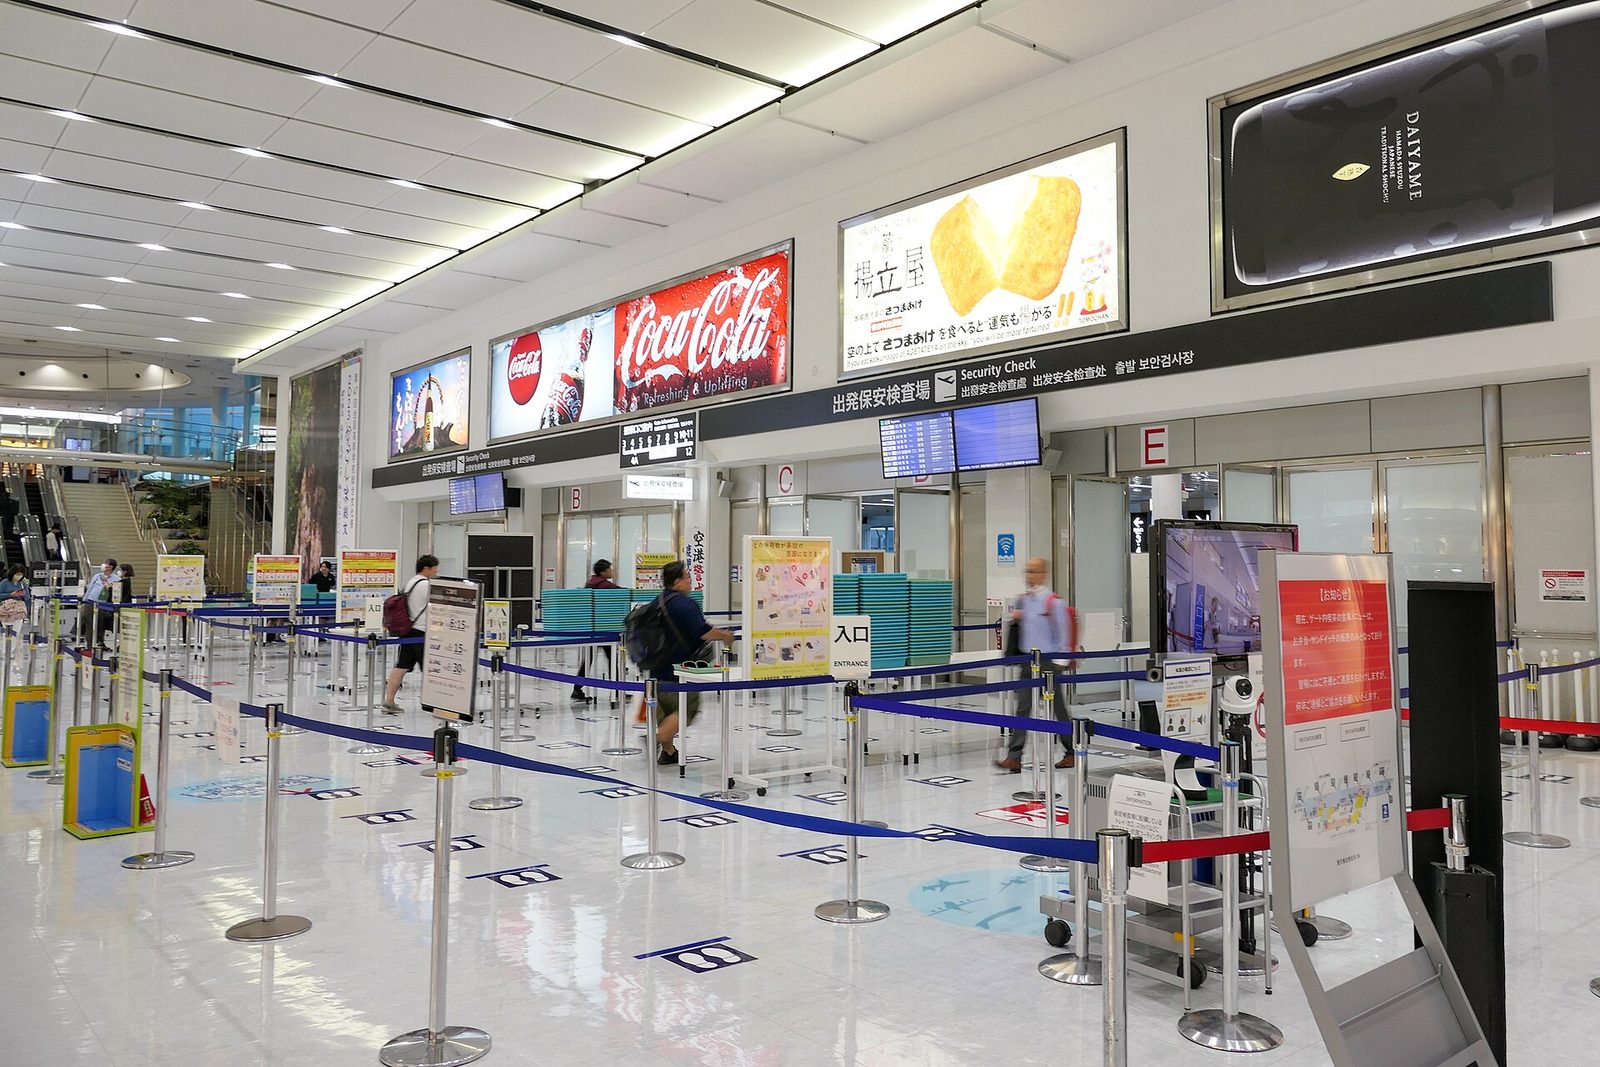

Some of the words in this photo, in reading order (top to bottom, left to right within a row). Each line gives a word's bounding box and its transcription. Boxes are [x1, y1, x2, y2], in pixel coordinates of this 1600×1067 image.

[1388, 145, 1396, 179] JAPANESE
[1406, 111, 1422, 201] DAIYAME
[854, 245, 925, 299] 揚立屋
[619, 267, 780, 390] Coca-Cola
[508, 349, 541, 381] Coca-Cola
[961, 364, 1002, 381] Security
[1004, 357, 1037, 373] Check
[1115, 359, 1137, 375] 출발
[1139, 350, 1195, 371] 보안검사장
[1033, 364, 1107, 388] 出发安全检查处
[644, 387, 689, 406] Refreshing
[693, 382, 701, 397] &
[704, 374, 748, 395] Uplifting
[833, 379, 931, 415] 出発保安検査場
[665, 432, 670, 441] 8
[674, 431, 679, 440] 9
[1144, 427, 1166, 465] E
[685, 446, 693, 457] 12
[778, 465, 793, 494] C
[572, 488, 581, 510] B
[1320, 587, 1352, 602] 【お知らせ】
[367, 603, 381, 613] 入口
[834, 625, 869, 644] 入口
[833, 660, 869, 668] ENTRANCE
